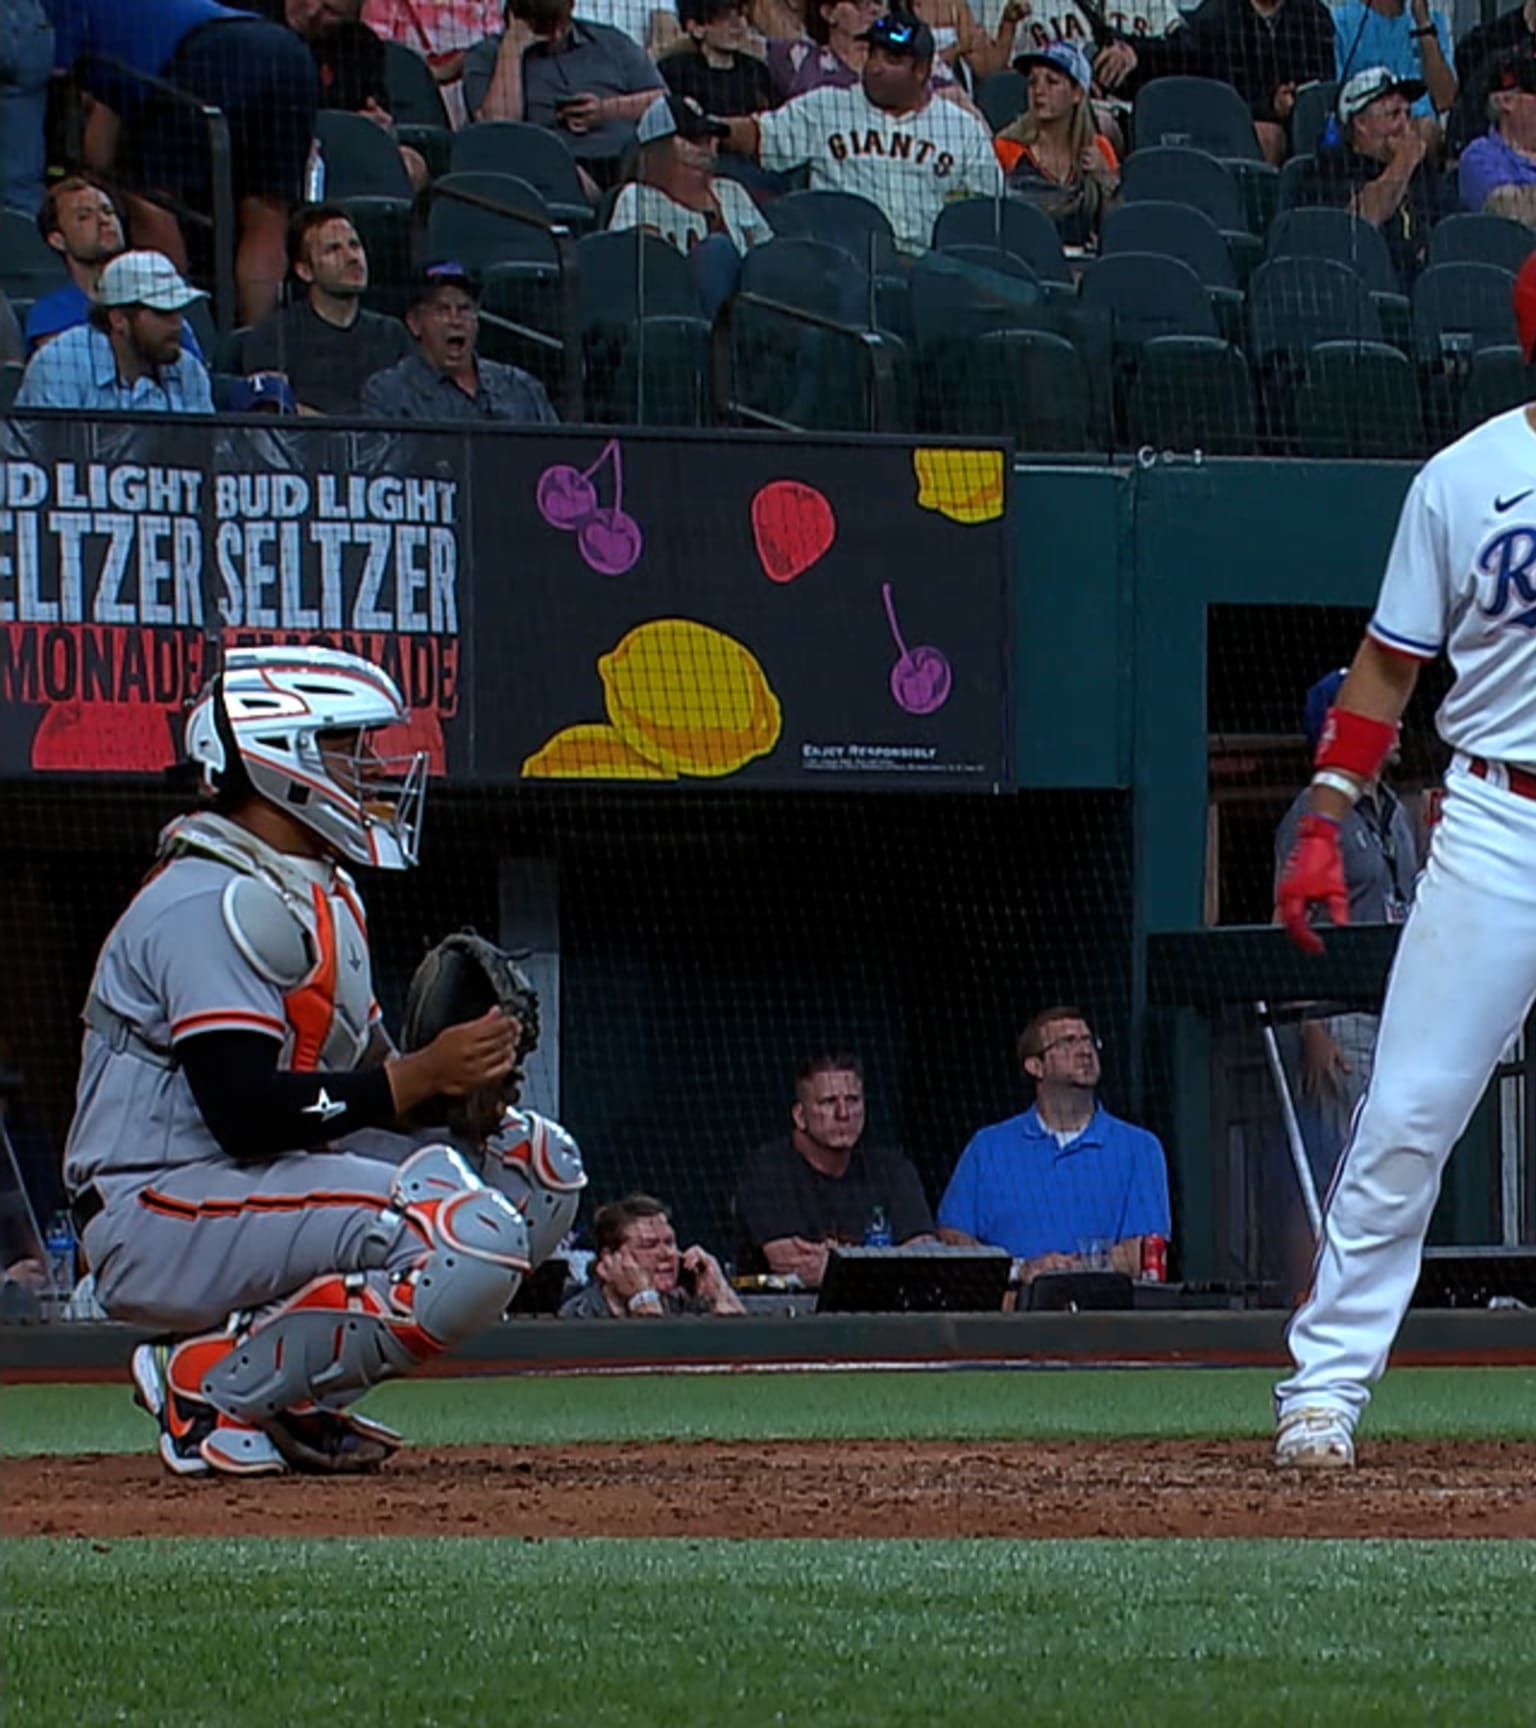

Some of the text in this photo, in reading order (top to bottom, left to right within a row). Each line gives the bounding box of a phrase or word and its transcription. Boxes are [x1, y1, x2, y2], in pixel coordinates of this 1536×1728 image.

[828, 128, 954, 178] GIANTS
[56, 461, 202, 514] LIGHT
[215, 474, 457, 523] BUD LIGHT
[216, 519, 458, 634] SELTZER
